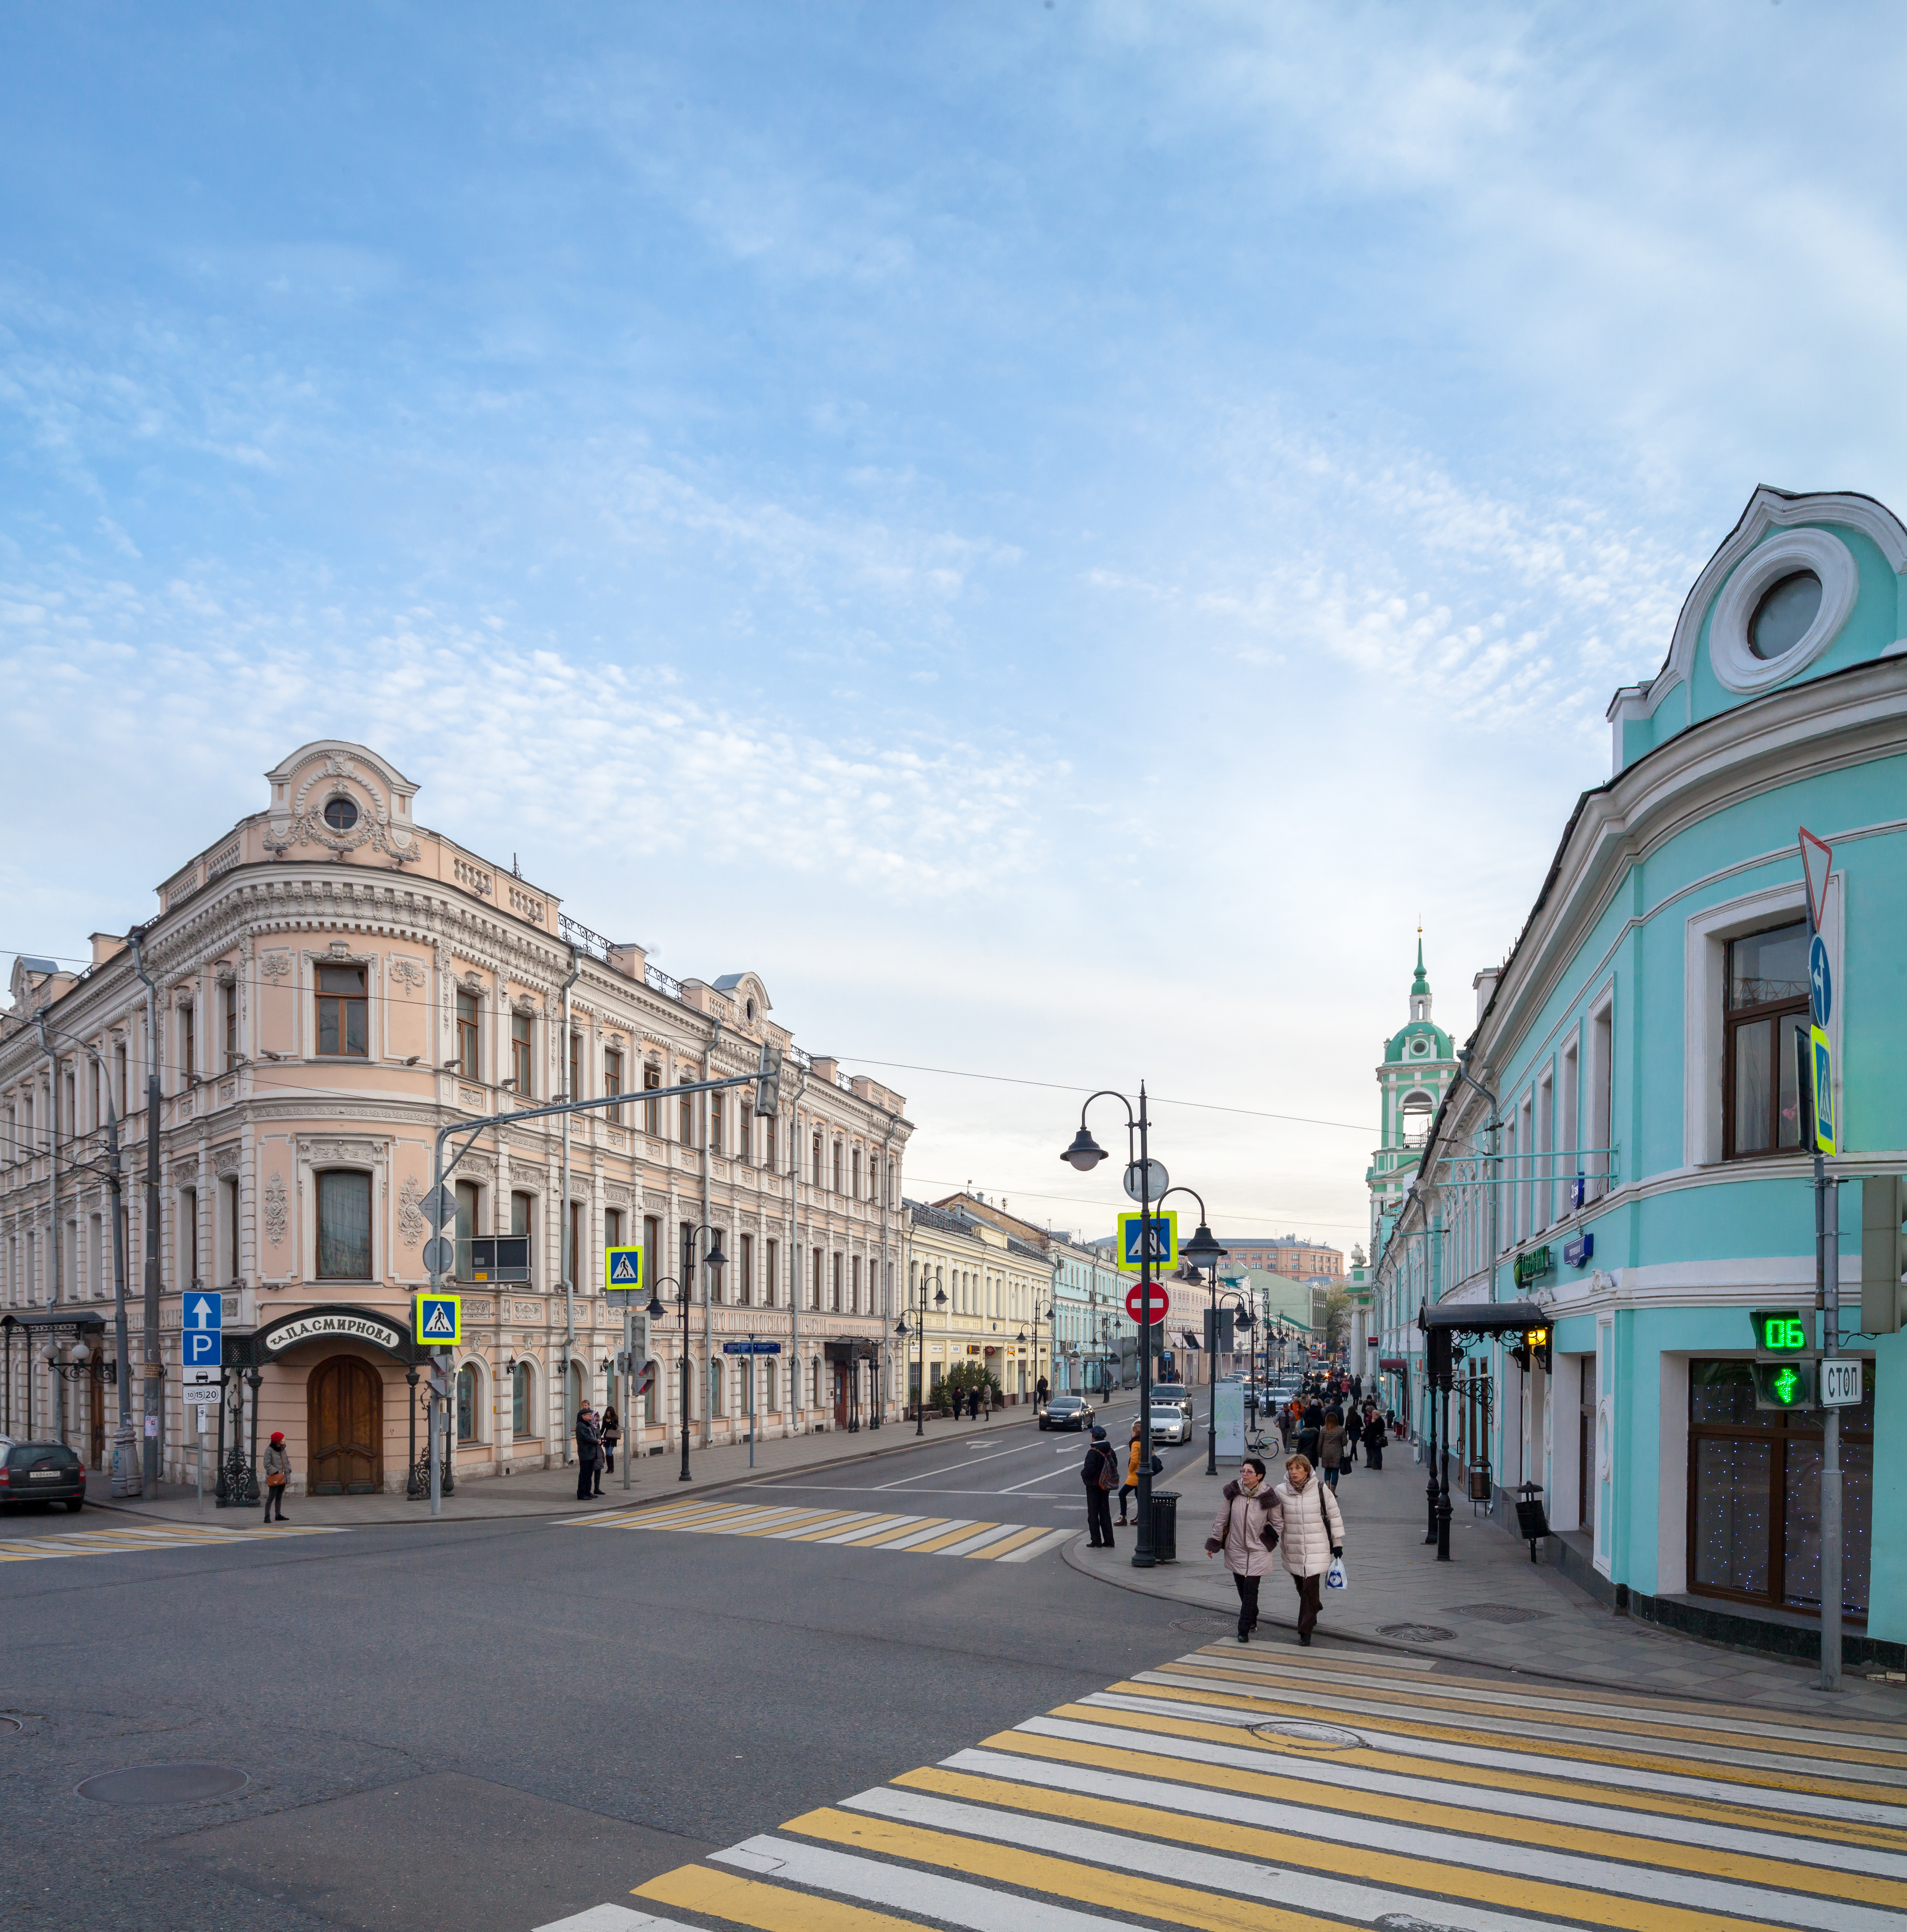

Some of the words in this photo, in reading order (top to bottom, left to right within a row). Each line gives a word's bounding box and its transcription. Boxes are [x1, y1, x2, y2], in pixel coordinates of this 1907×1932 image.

[1522, 1246, 1546, 1275] СБЕРБАНК
[312, 1319, 391, 1344] СМИРНОВА
[712, 1312, 726, 1331] ЕГО
[729, 1313, 788, 1333] ИМПЕРАТОРСКАГО
[1766, 1319, 1804, 1347] 06
[193, 1335, 212, 1361] P
[1828, 1367, 1857, 1398] СТОП
